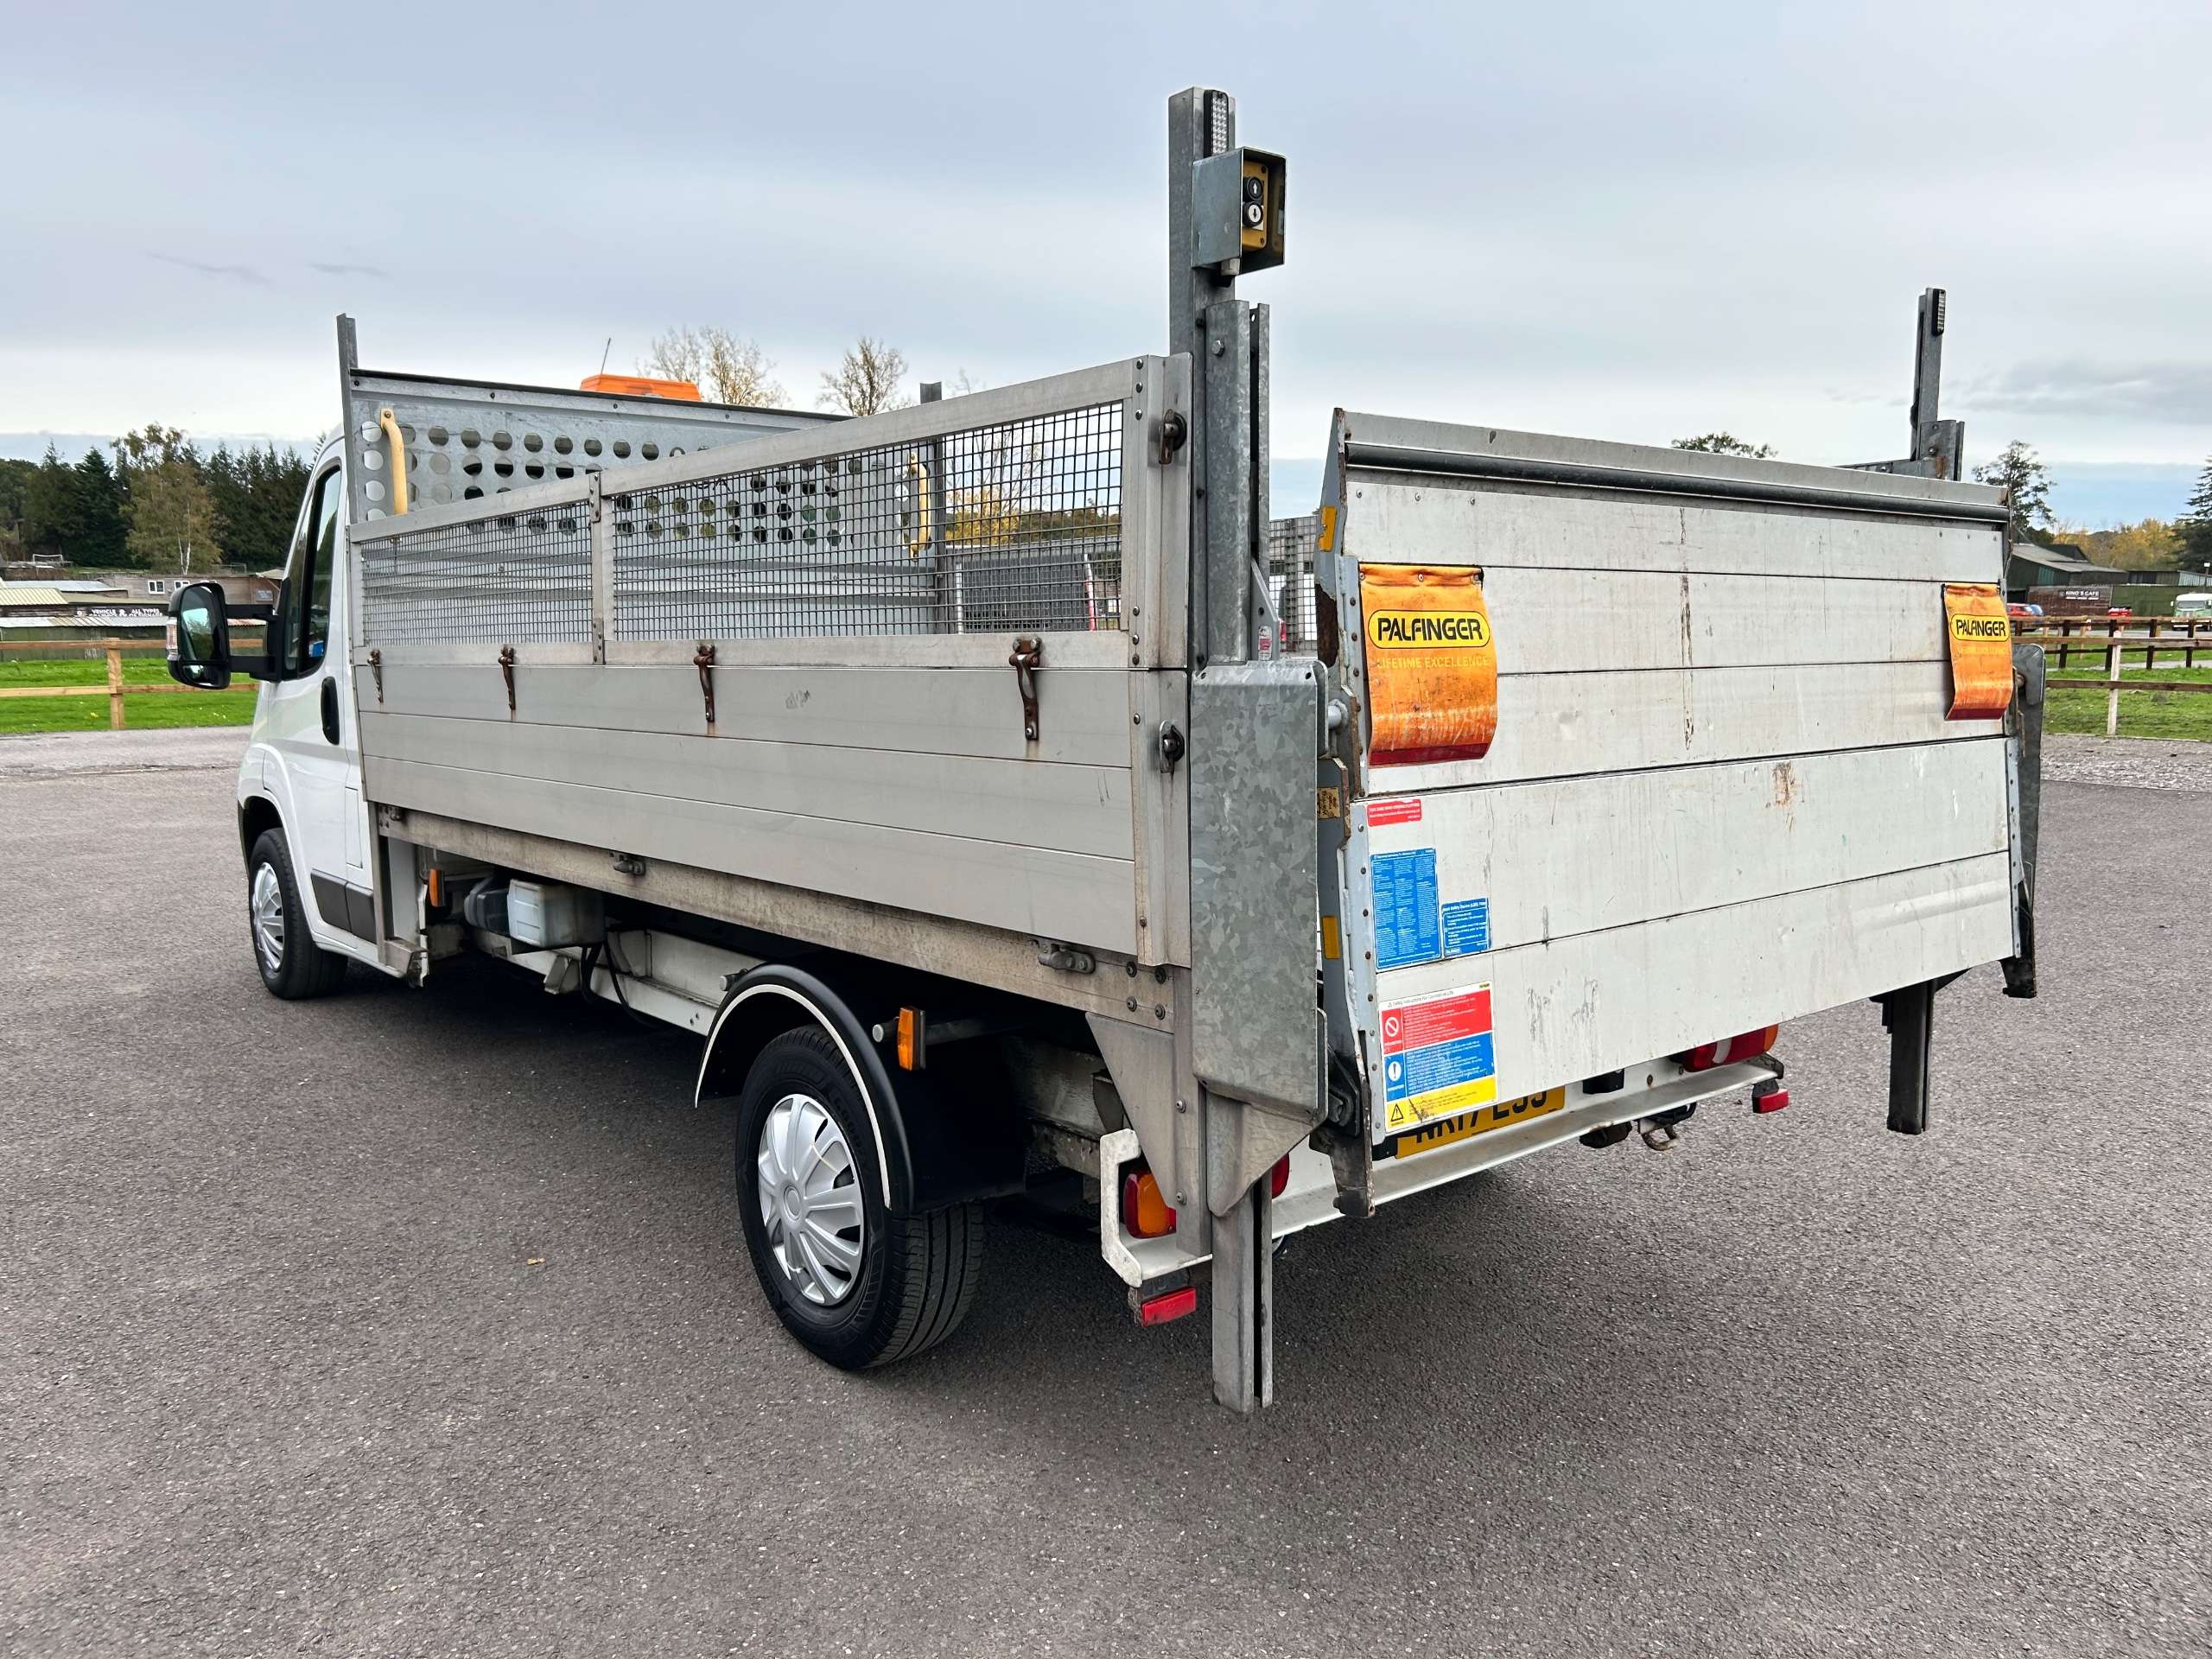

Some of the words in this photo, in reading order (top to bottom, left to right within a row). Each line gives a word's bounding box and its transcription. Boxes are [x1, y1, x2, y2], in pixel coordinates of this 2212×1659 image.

[1377, 617, 1483, 642] PALFINGER
[1955, 619, 2006, 637] PALFINGER
[1377, 657, 1423, 670] LIFETIME
[1424, 656, 1490, 668] EXCELLENCE
